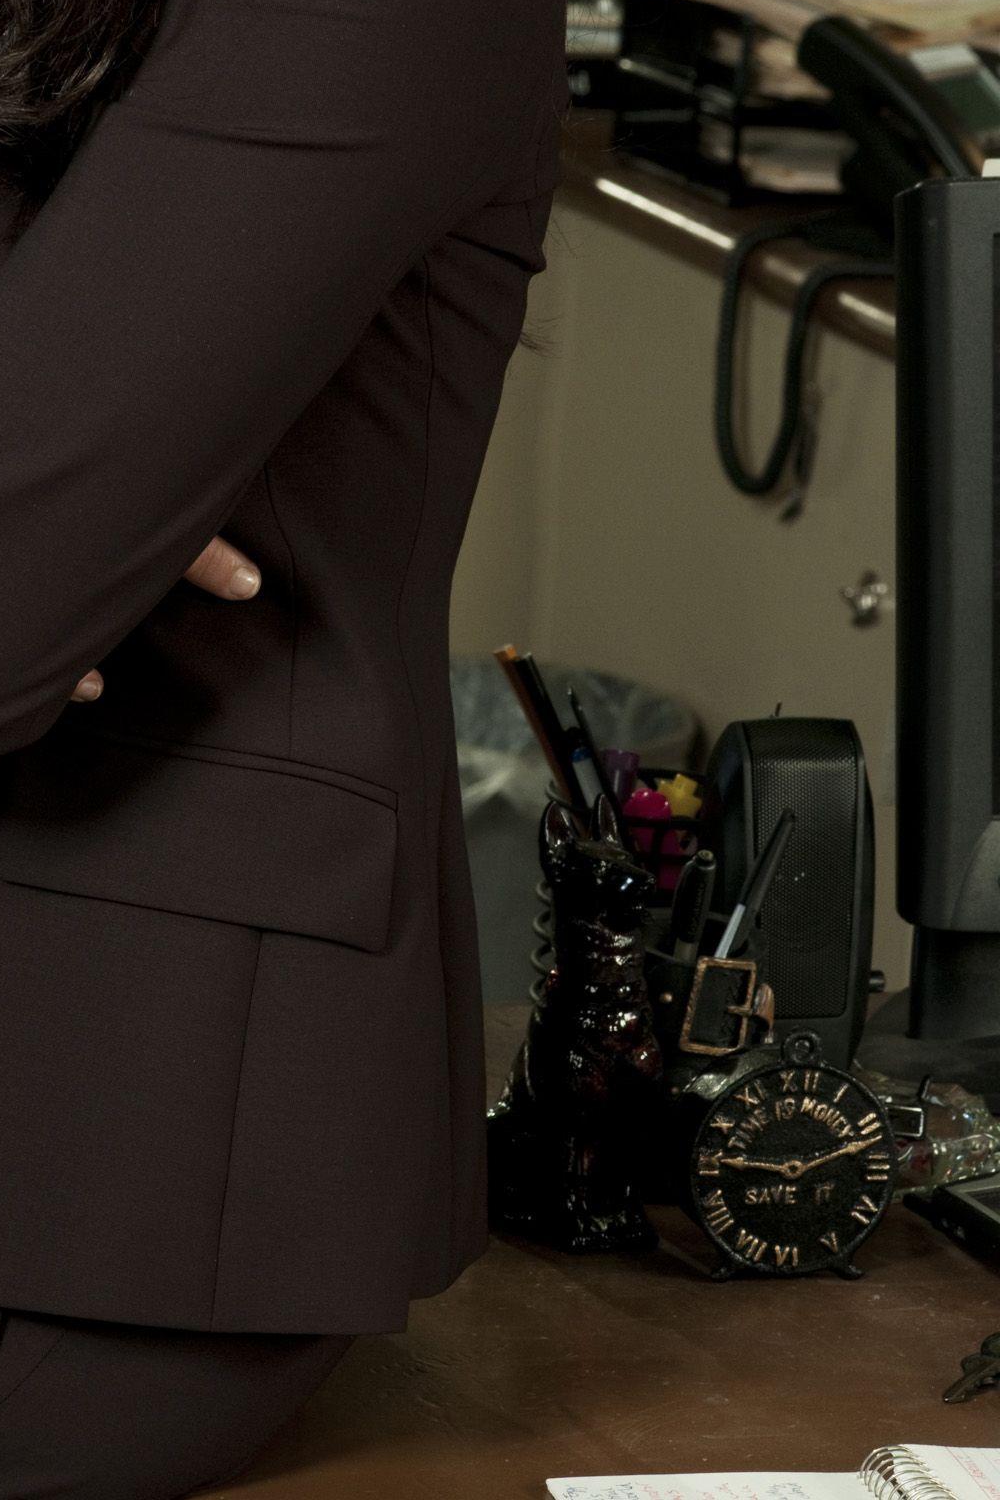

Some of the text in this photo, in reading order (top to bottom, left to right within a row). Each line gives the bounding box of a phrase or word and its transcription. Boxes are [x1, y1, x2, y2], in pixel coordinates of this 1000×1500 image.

[728, 1096, 856, 1151] TIME IS MONEY
[744, 1182, 837, 1205] SAVE IT
